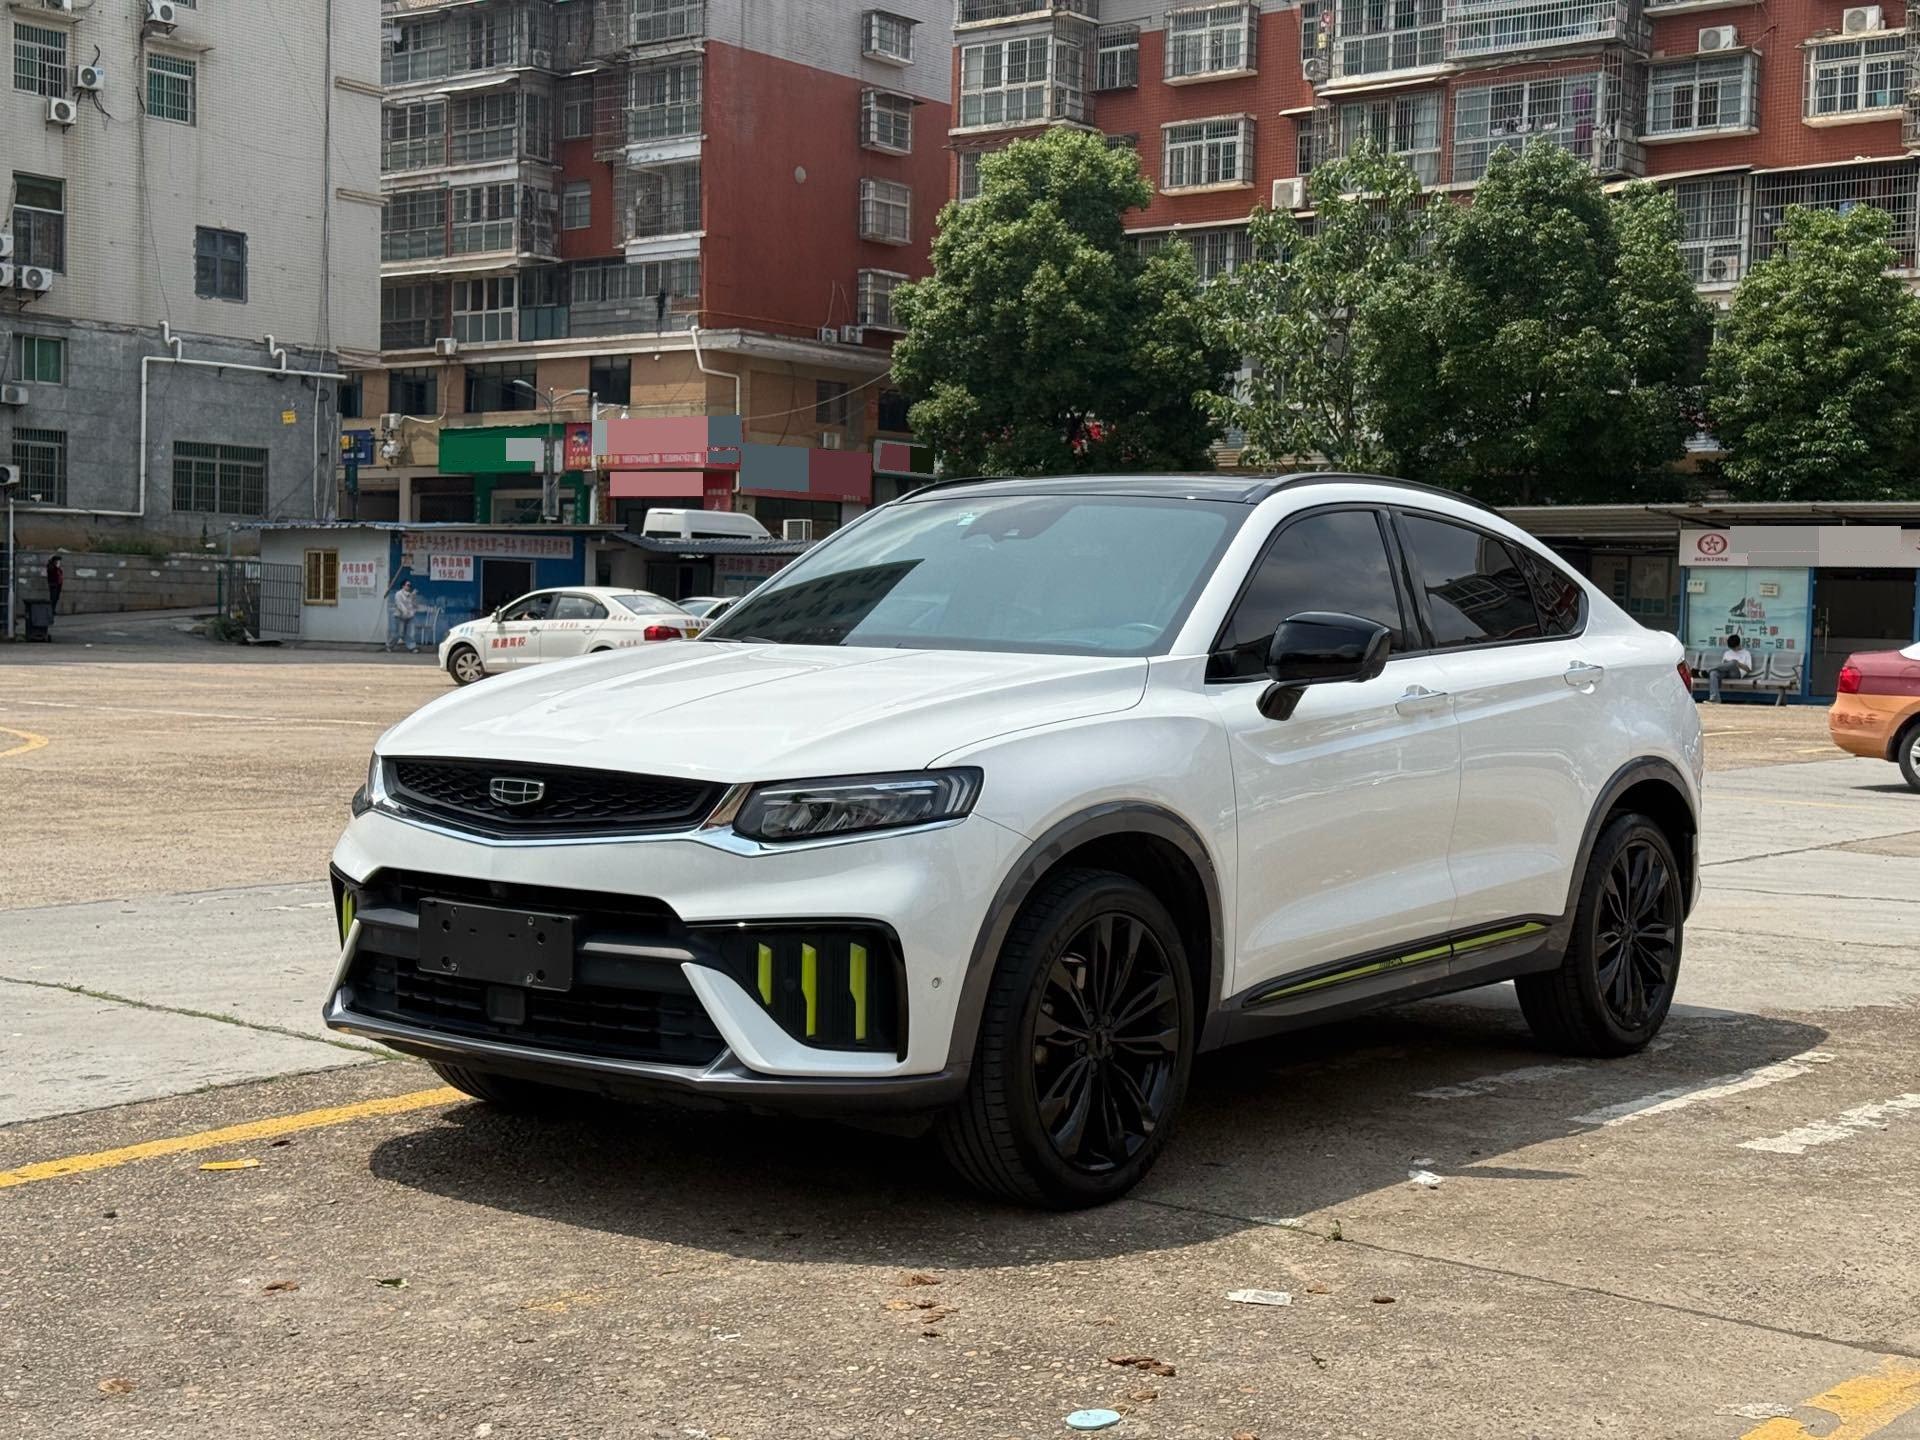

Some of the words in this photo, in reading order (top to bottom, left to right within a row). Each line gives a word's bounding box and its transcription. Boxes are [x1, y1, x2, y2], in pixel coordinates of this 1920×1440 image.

[432, 556, 471, 568] 内有自助餐
[342, 563, 374, 573] 内有自助餐
[1715, 625, 1744, 635] 一群人
